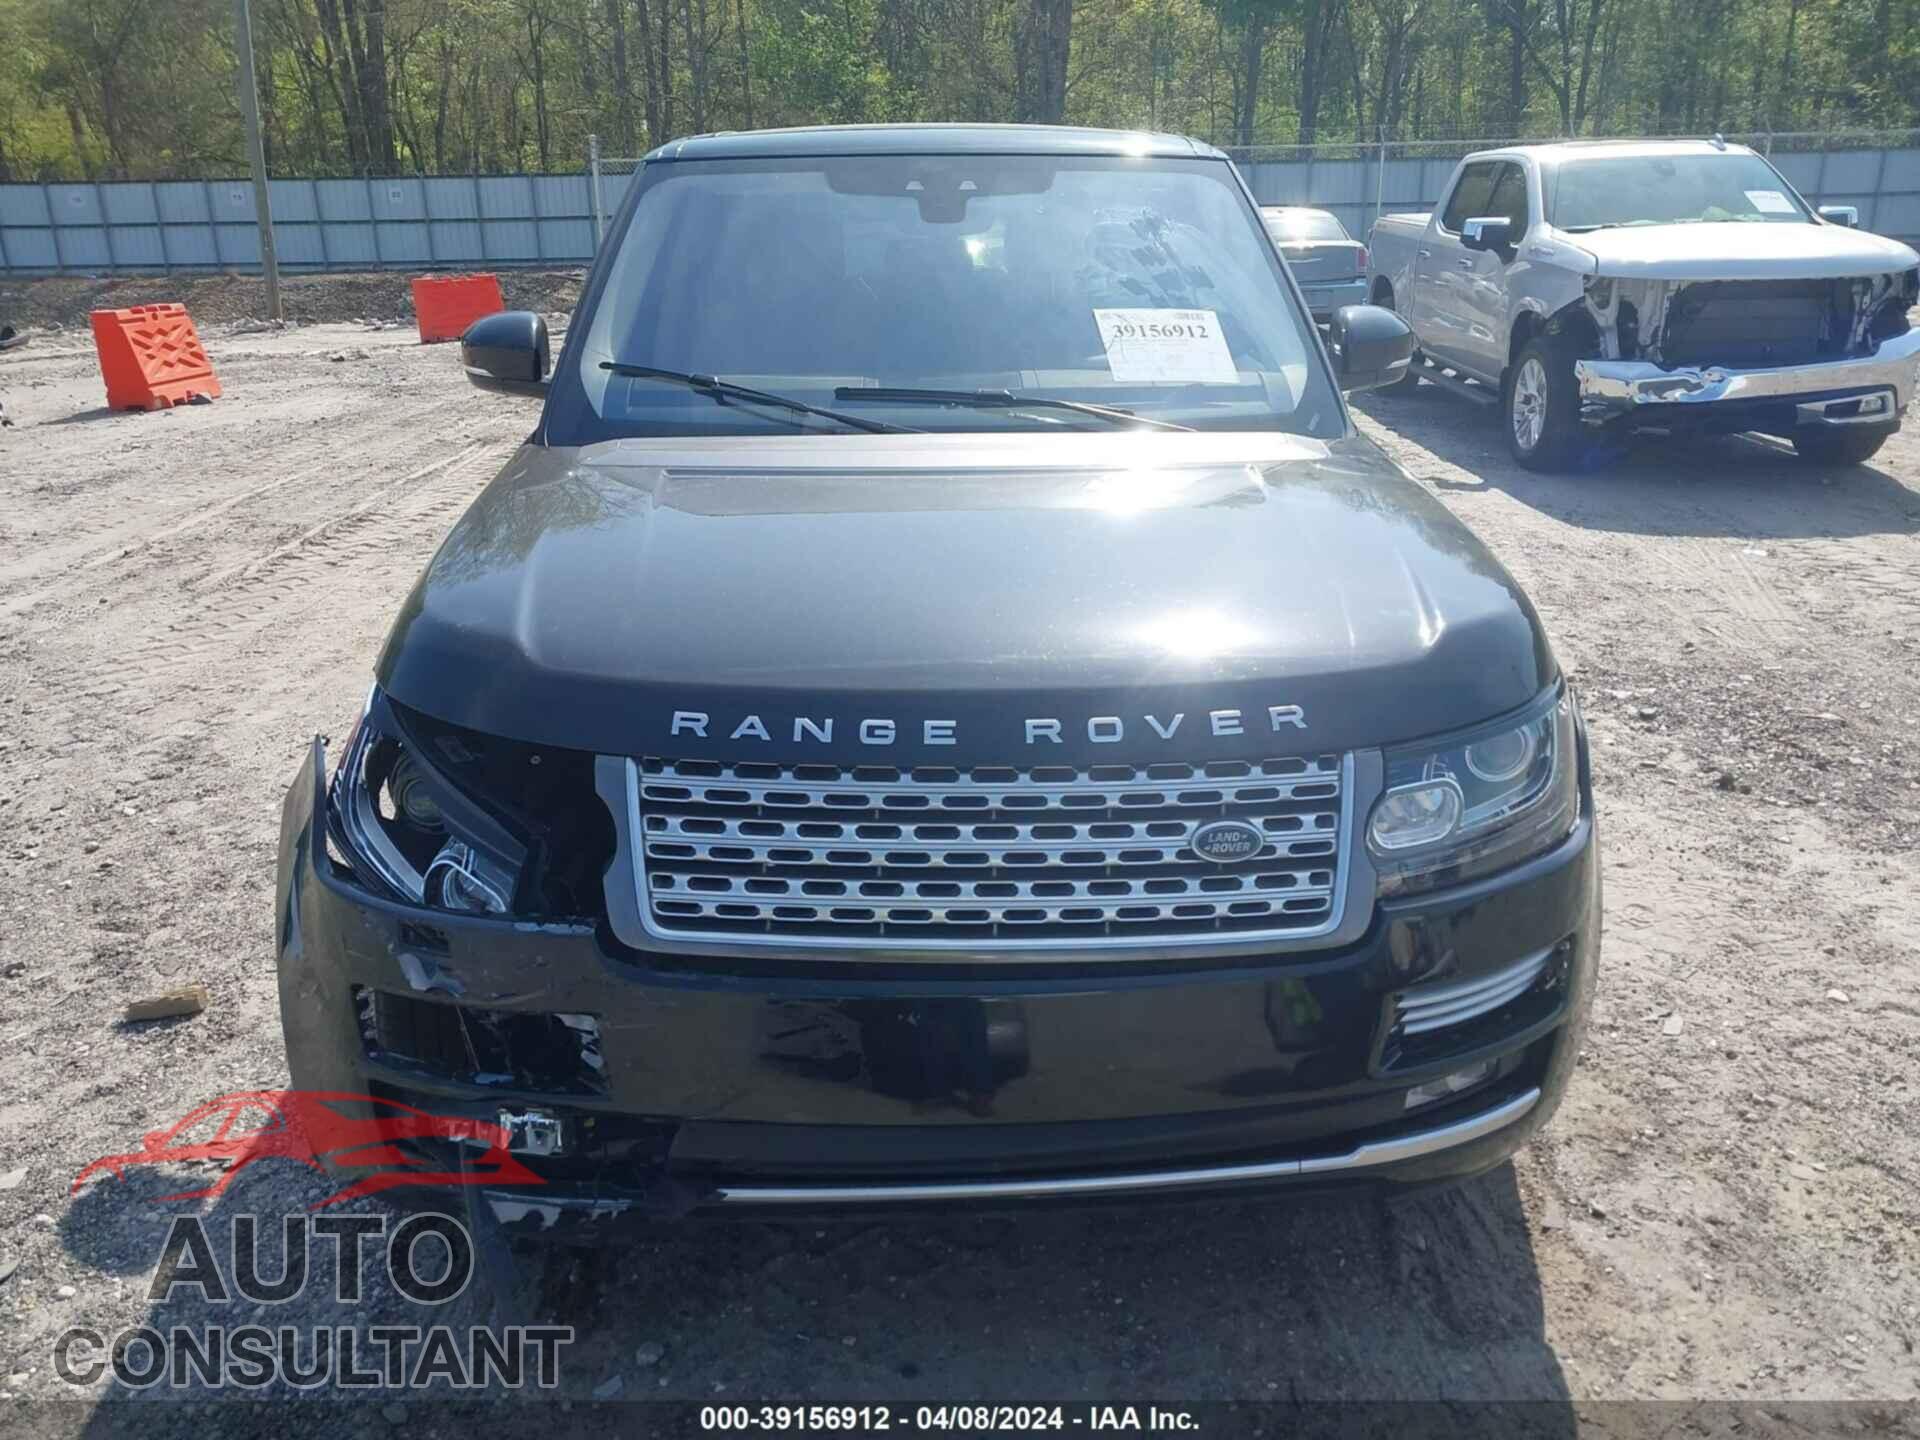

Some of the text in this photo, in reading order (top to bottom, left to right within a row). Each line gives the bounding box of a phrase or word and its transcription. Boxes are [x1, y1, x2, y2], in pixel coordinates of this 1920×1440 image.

[1113, 325, 1209, 338] 39156912
[671, 704, 1308, 745] RANGE ROVER
[1209, 832, 1241, 842] LAND
[1212, 843, 1250, 853] ROVER
